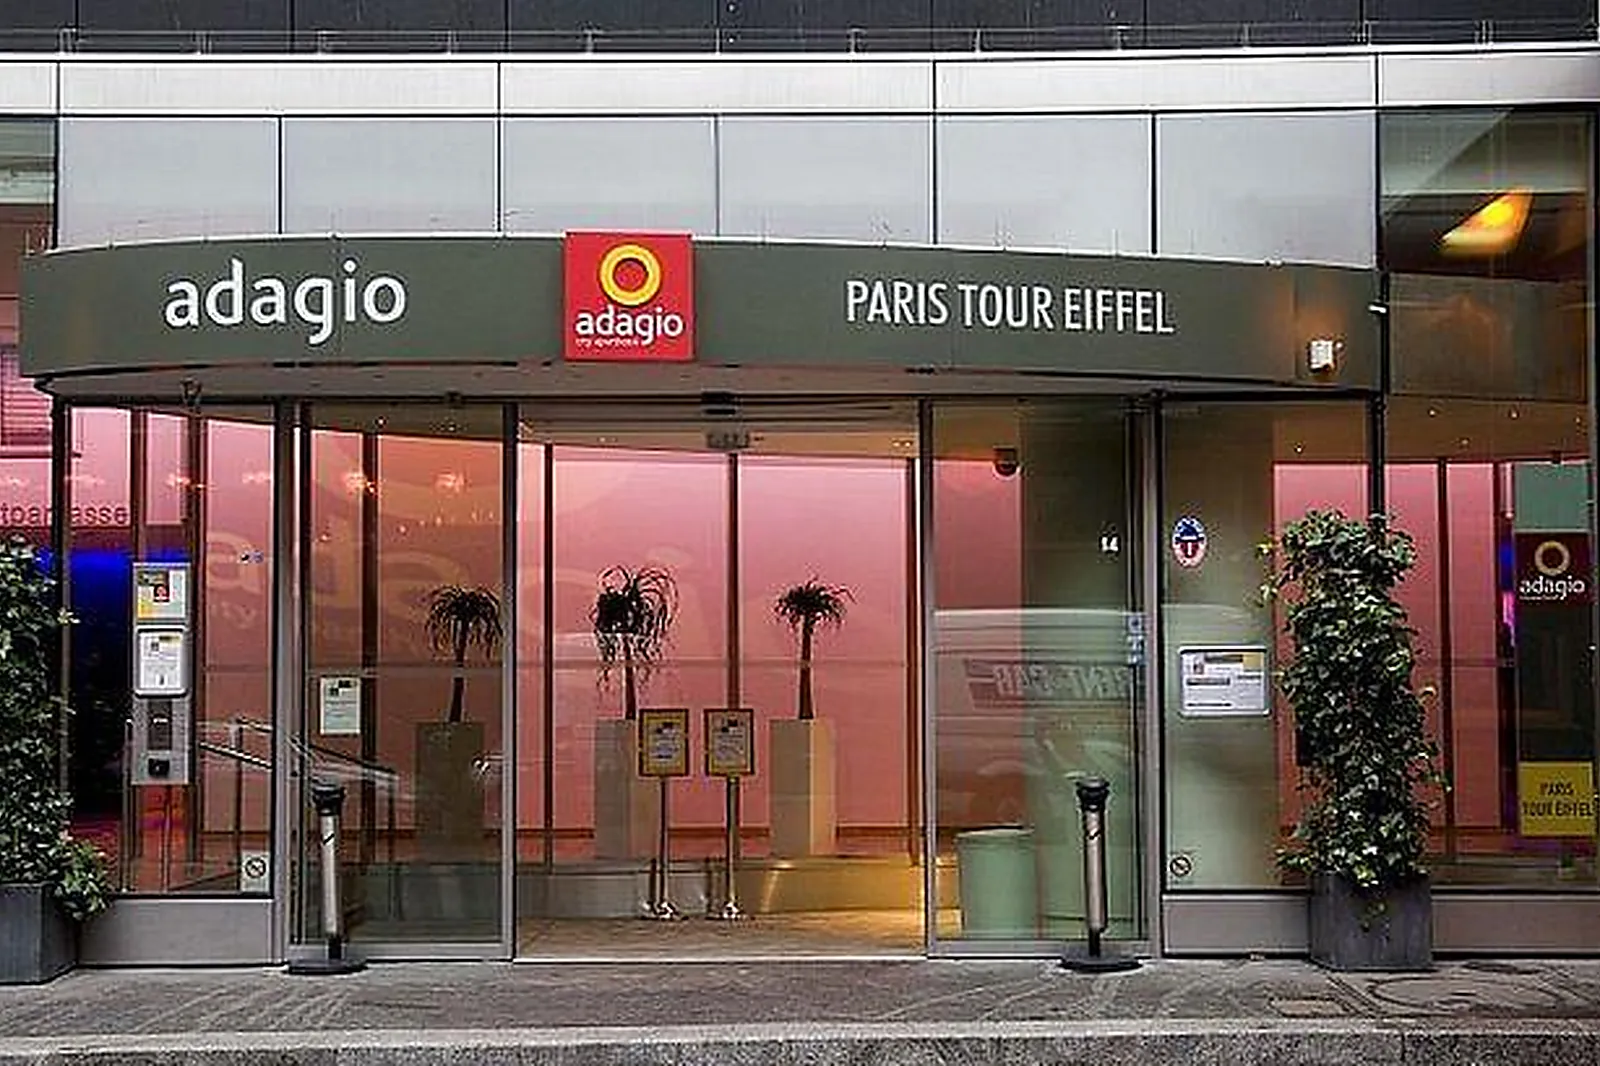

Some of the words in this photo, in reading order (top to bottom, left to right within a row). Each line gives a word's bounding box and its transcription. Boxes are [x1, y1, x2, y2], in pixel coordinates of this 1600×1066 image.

[165, 258, 406, 345] adagio
[575, 303, 684, 346] adagio
[847, 280, 948, 325] PARIS
[958, 284, 1054, 328] TOUR
[1064, 288, 1175, 334] EIFFEL
[1519, 575, 1586, 600] adagio
